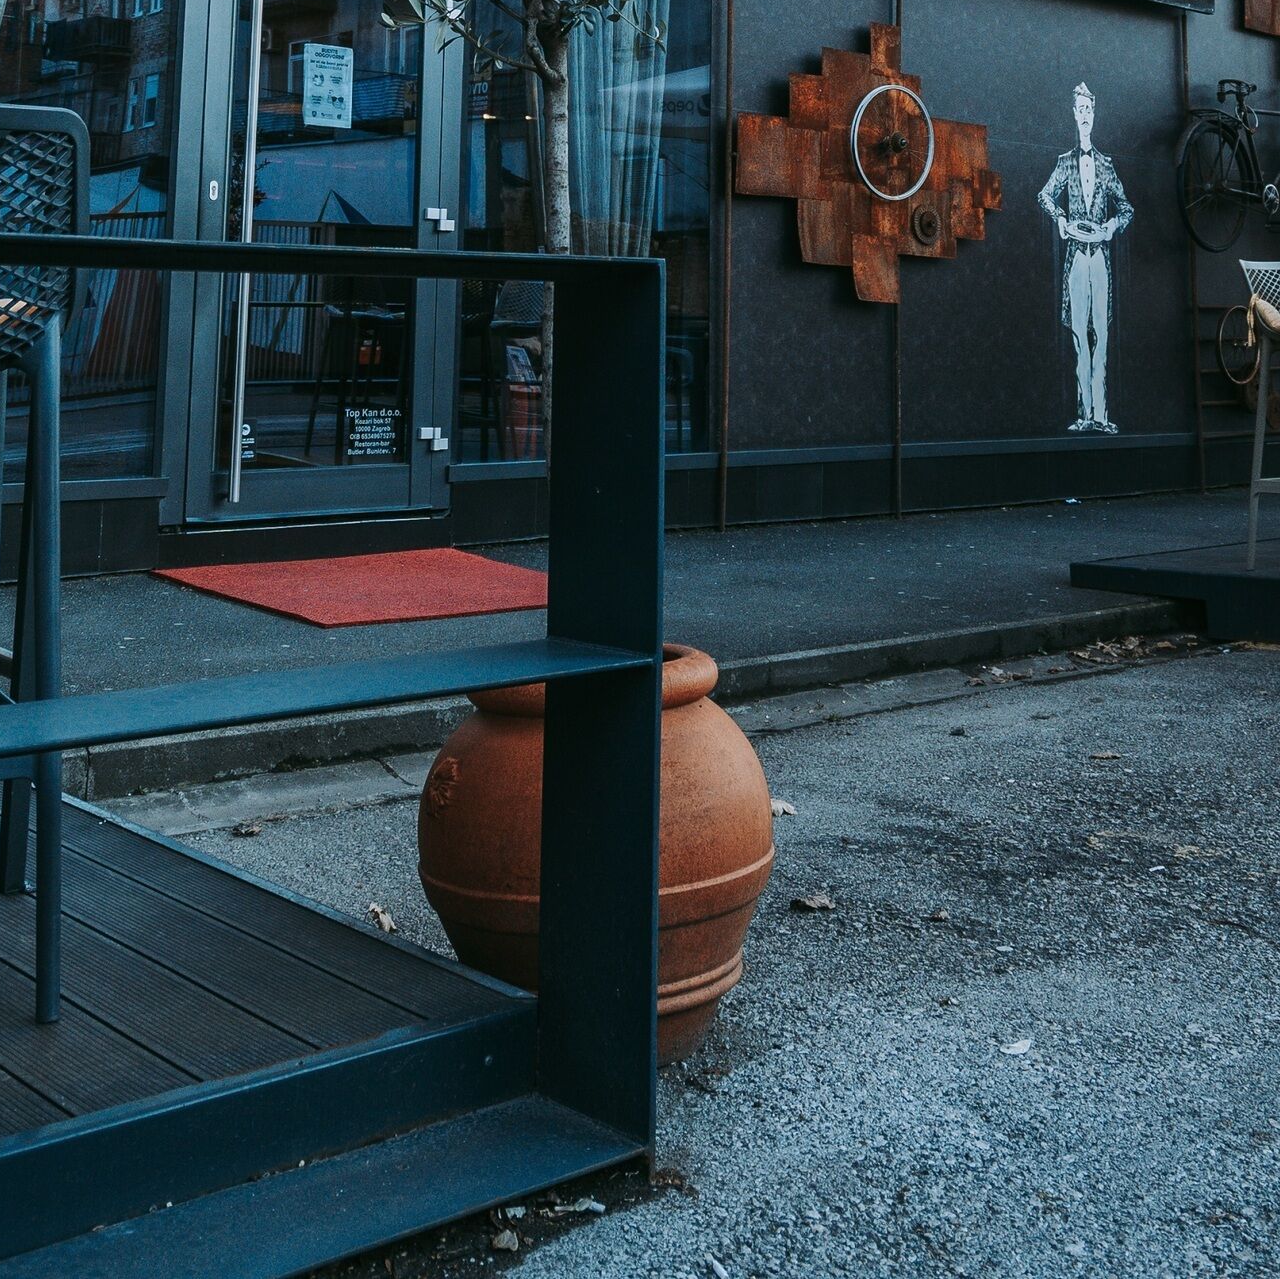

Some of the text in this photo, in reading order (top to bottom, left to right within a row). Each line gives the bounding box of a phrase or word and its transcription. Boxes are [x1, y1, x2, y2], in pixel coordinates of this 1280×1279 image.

[345, 408, 402, 419] Top Kan d.o.o.
[372, 425, 391, 433] Zagreb
